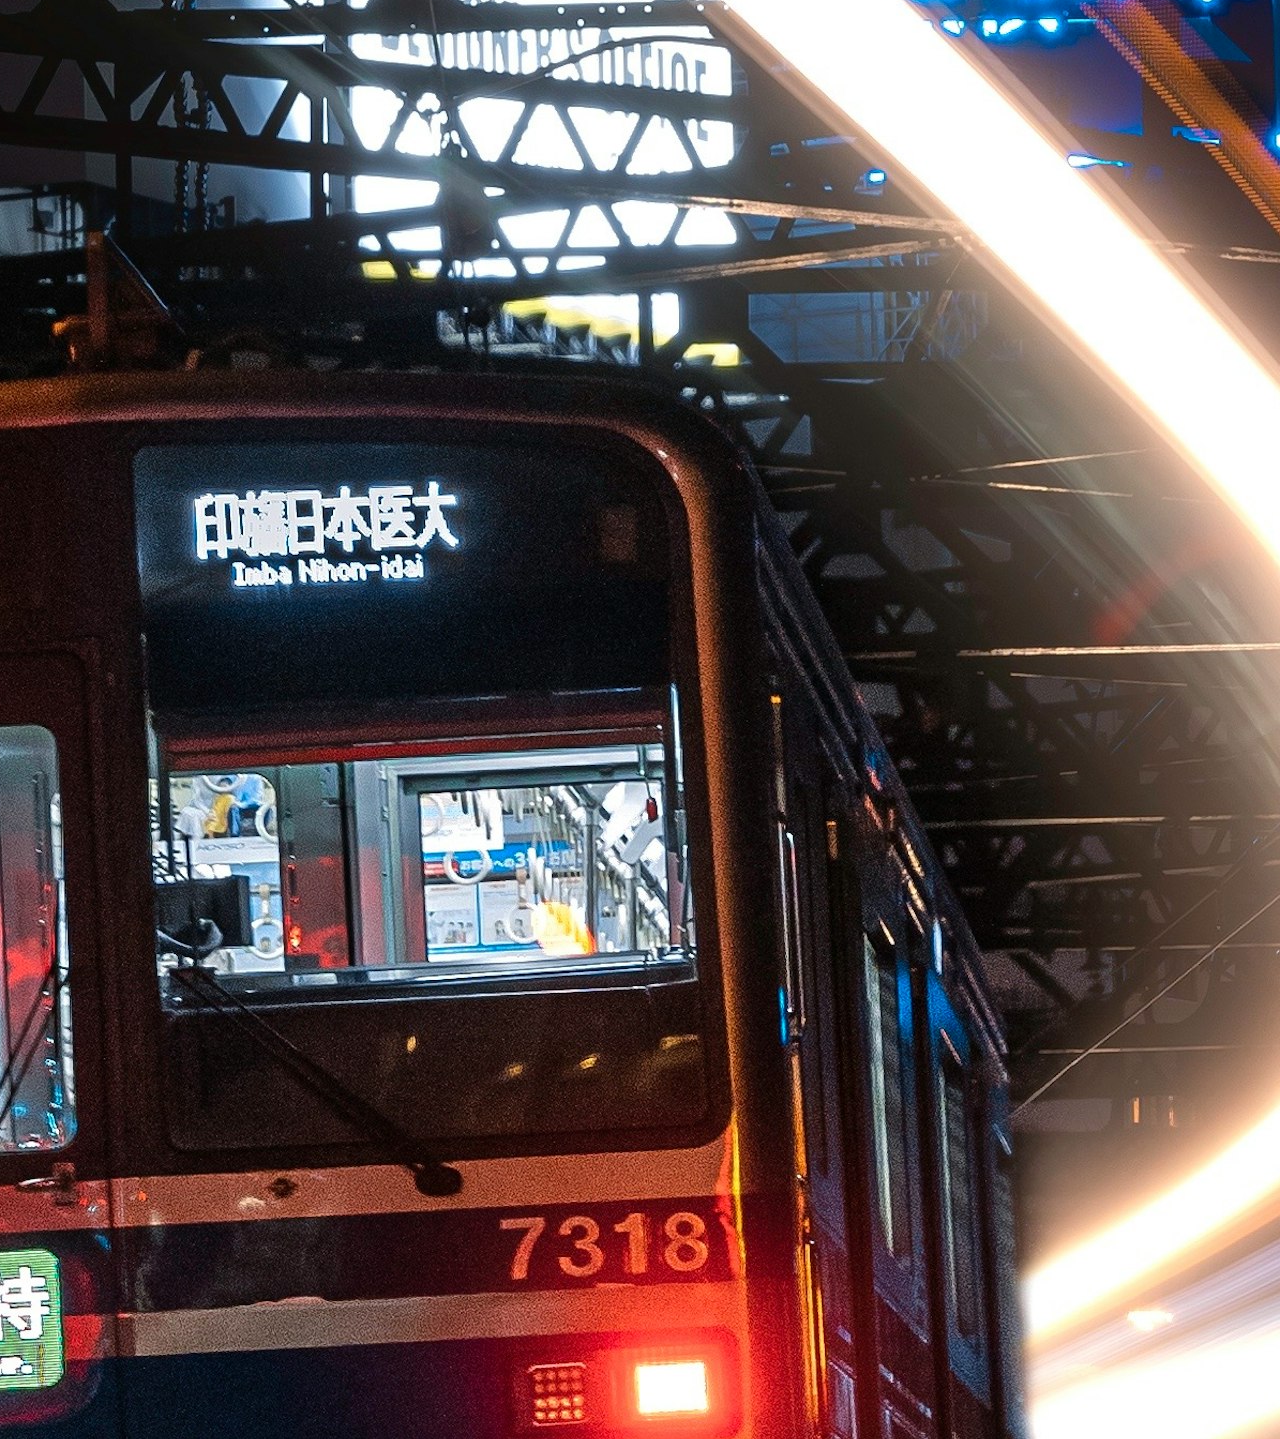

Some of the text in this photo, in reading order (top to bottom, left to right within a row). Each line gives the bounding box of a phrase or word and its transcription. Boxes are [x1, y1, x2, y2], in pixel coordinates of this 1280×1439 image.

[231, 553, 424, 587] Imba Nihon-idai
[499, 1211, 709, 1281] 7318
